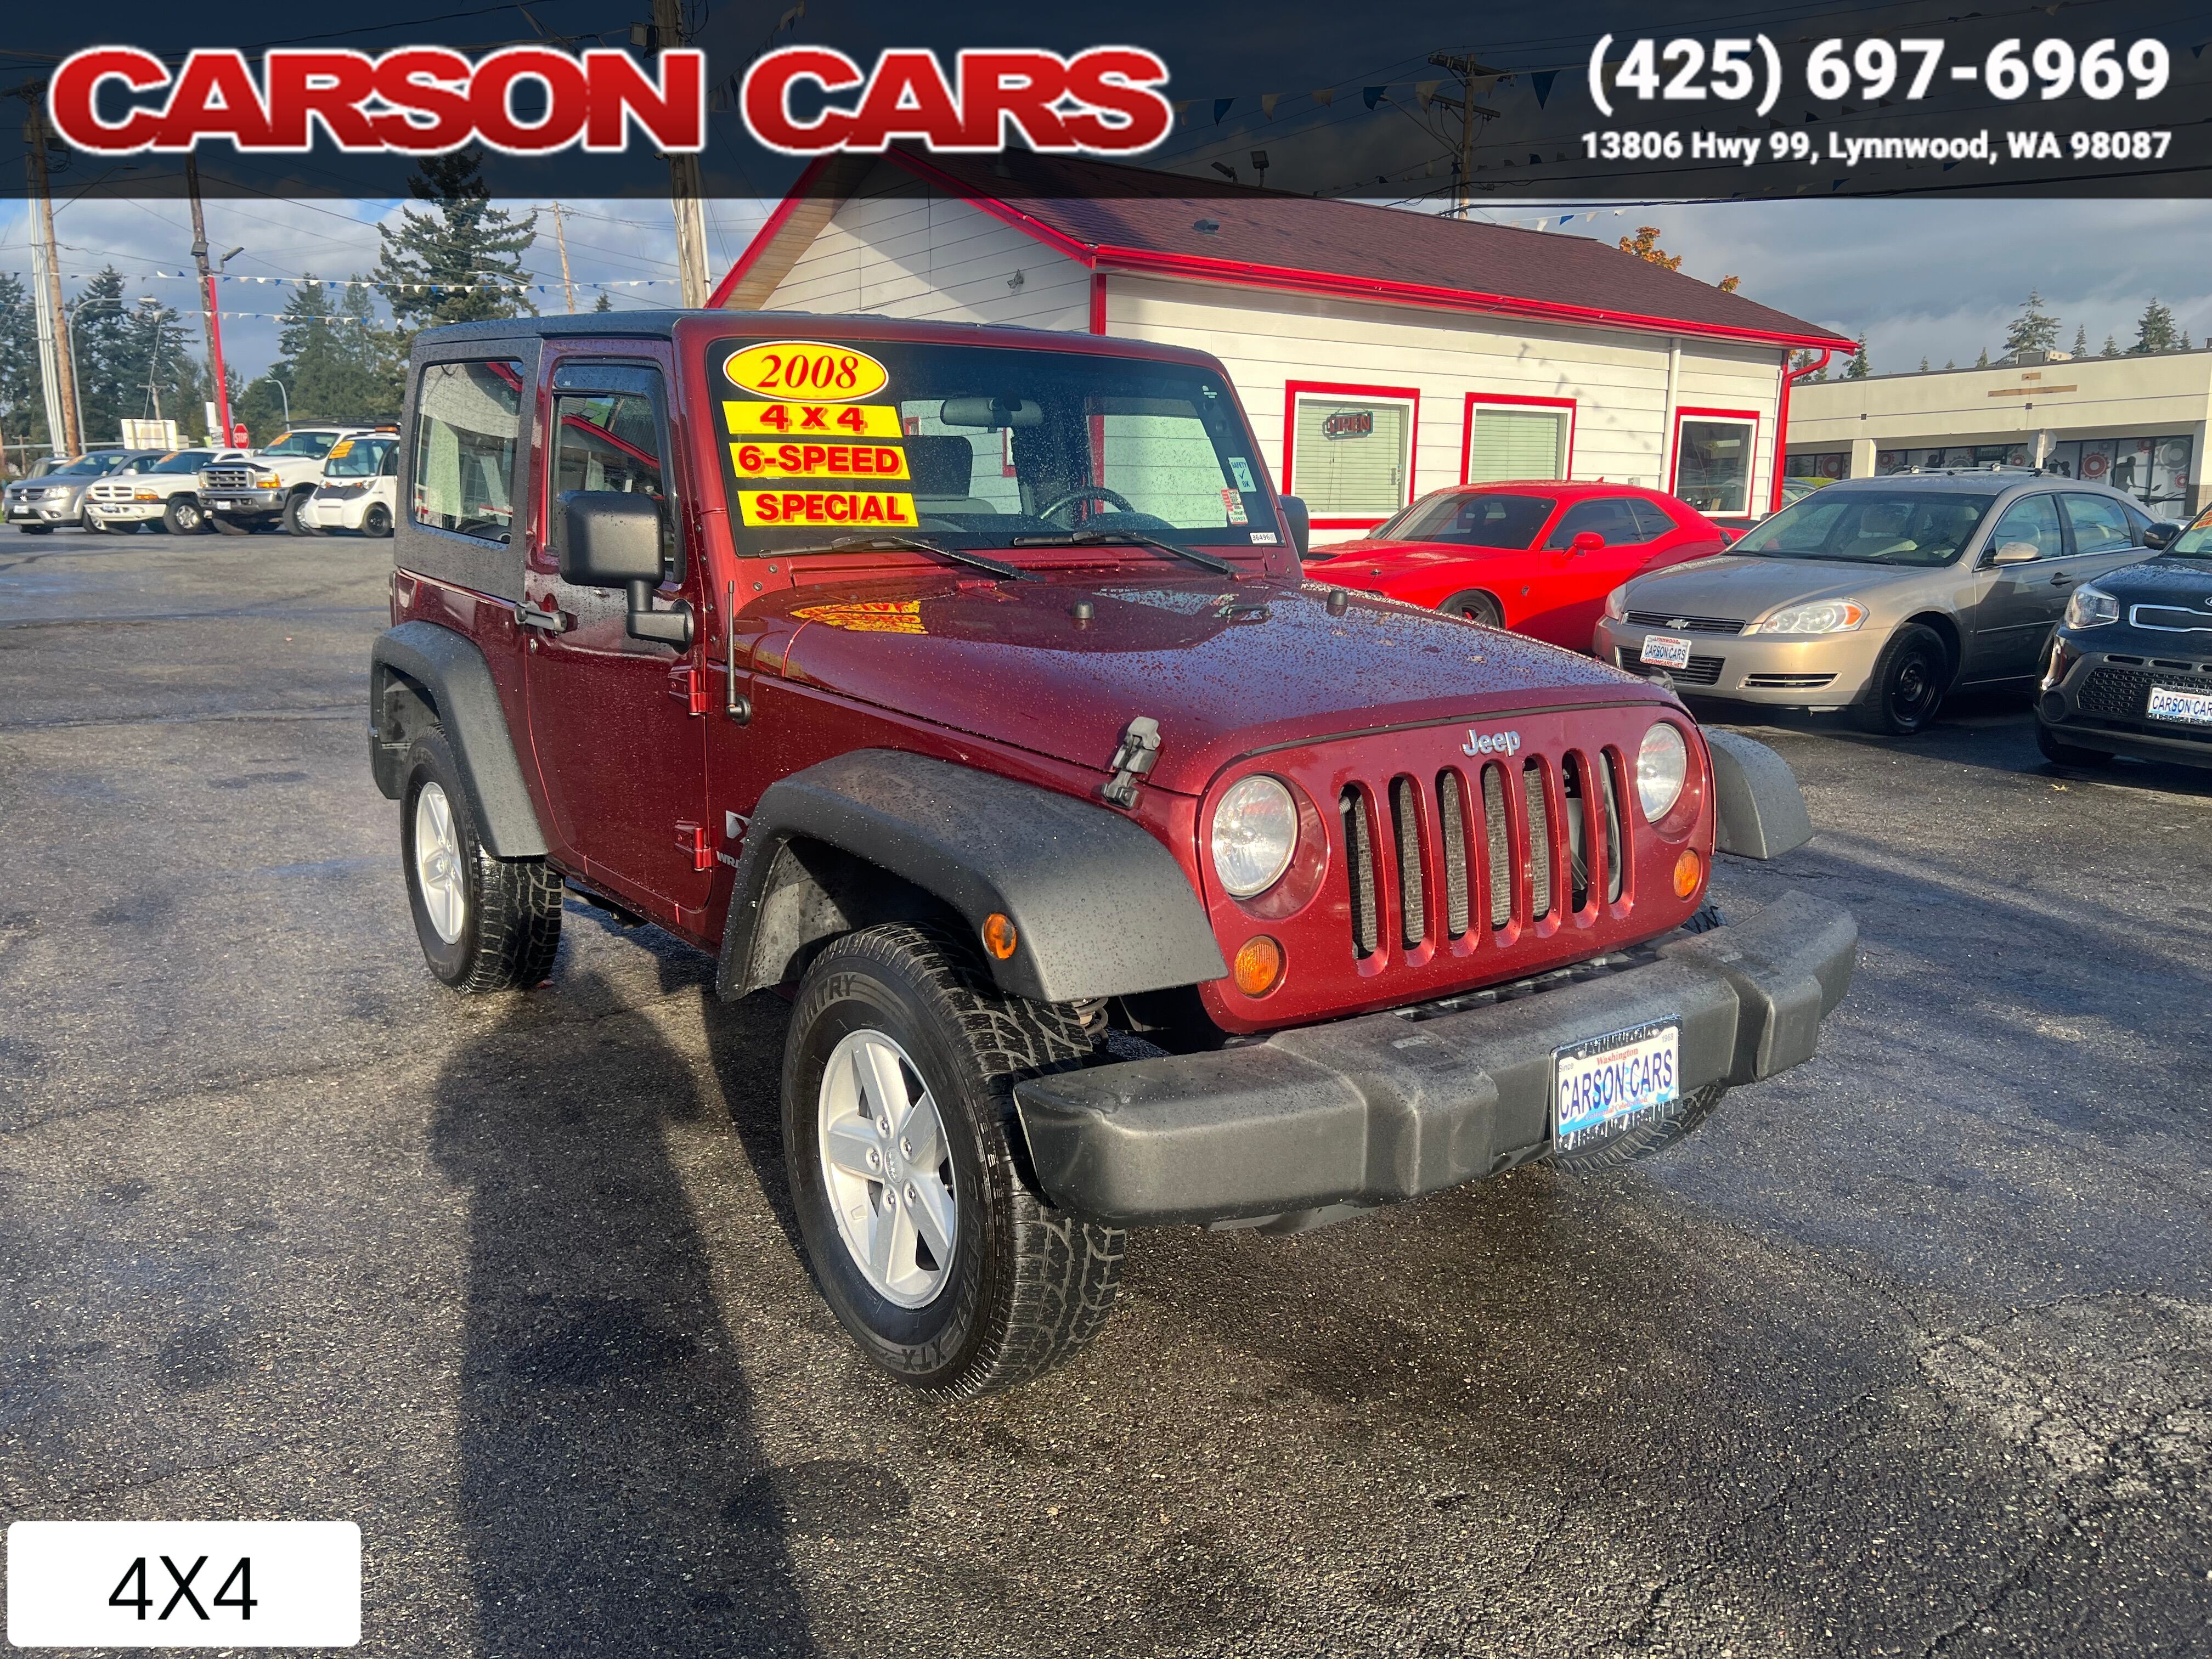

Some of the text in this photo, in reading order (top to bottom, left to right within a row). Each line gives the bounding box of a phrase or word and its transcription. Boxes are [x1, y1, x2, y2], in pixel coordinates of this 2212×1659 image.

[757, 354, 859, 389] 2008
[760, 404, 792, 433] 4
[837, 407, 868, 435] 4
[1329, 414, 1370, 432] OPEN
[738, 445, 903, 476] 6-SPEED
[755, 494, 909, 524] SPECIAL
[1645, 644, 1686, 661] CARSON CARS
[2152, 696, 2192, 714] CARSON
[1461, 729, 1521, 757] Jeep
[1558, 1063, 1574, 1073] Since
[1596, 1047, 1639, 1066] Washington
[1560, 1048, 1673, 1120] CARSON CARS
[901, 1334, 946, 1371] XTX
